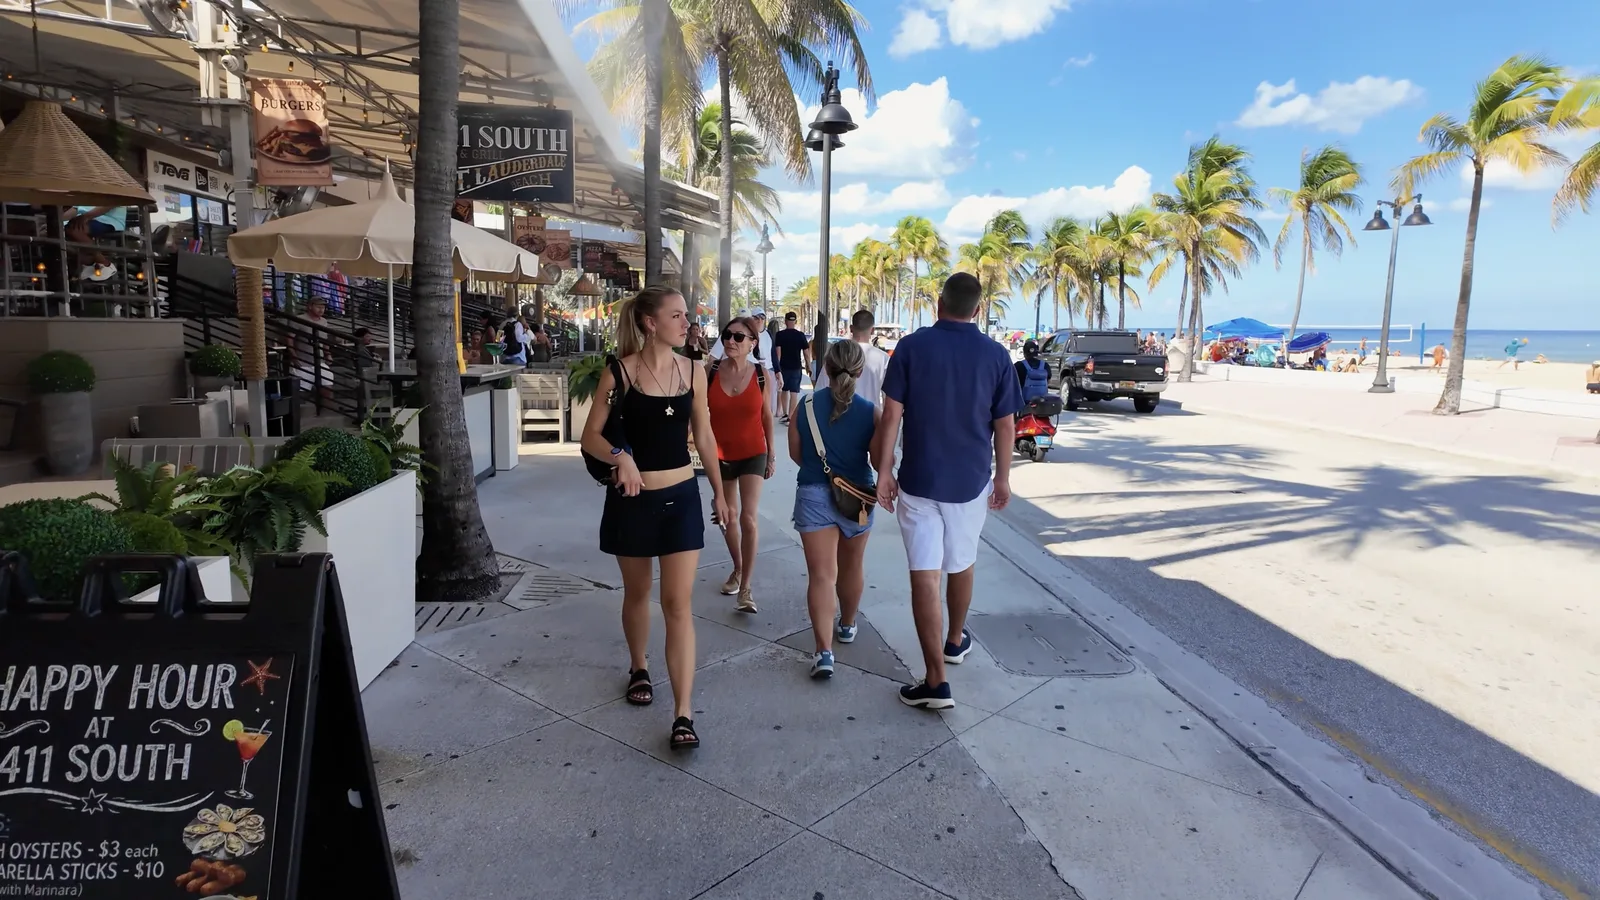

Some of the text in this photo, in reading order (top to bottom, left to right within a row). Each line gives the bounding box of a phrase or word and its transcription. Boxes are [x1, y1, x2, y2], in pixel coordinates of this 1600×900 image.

[261, 99, 321, 111] BURGERS
[457, 125, 568, 152] 1 SOUTH
[472, 149, 505, 160] GRILL
[474, 155, 567, 185] LAUDERDALE
[511, 172, 552, 188] BEACH
[516, 224, 544, 232] OYSTERS
[128, 663, 237, 710] HOUR
[84, 716, 114, 739] AT
[0, 743, 192, 783] 411 SOUTH
[9, 841, 83, 860] OYSTERS
[99, 839, 120, 859] $3
[125, 844, 159, 858] each
[59, 862, 118, 880] STICKS
[134, 861, 165, 879] $10
[25, 883, 83, 897] Marinara)
